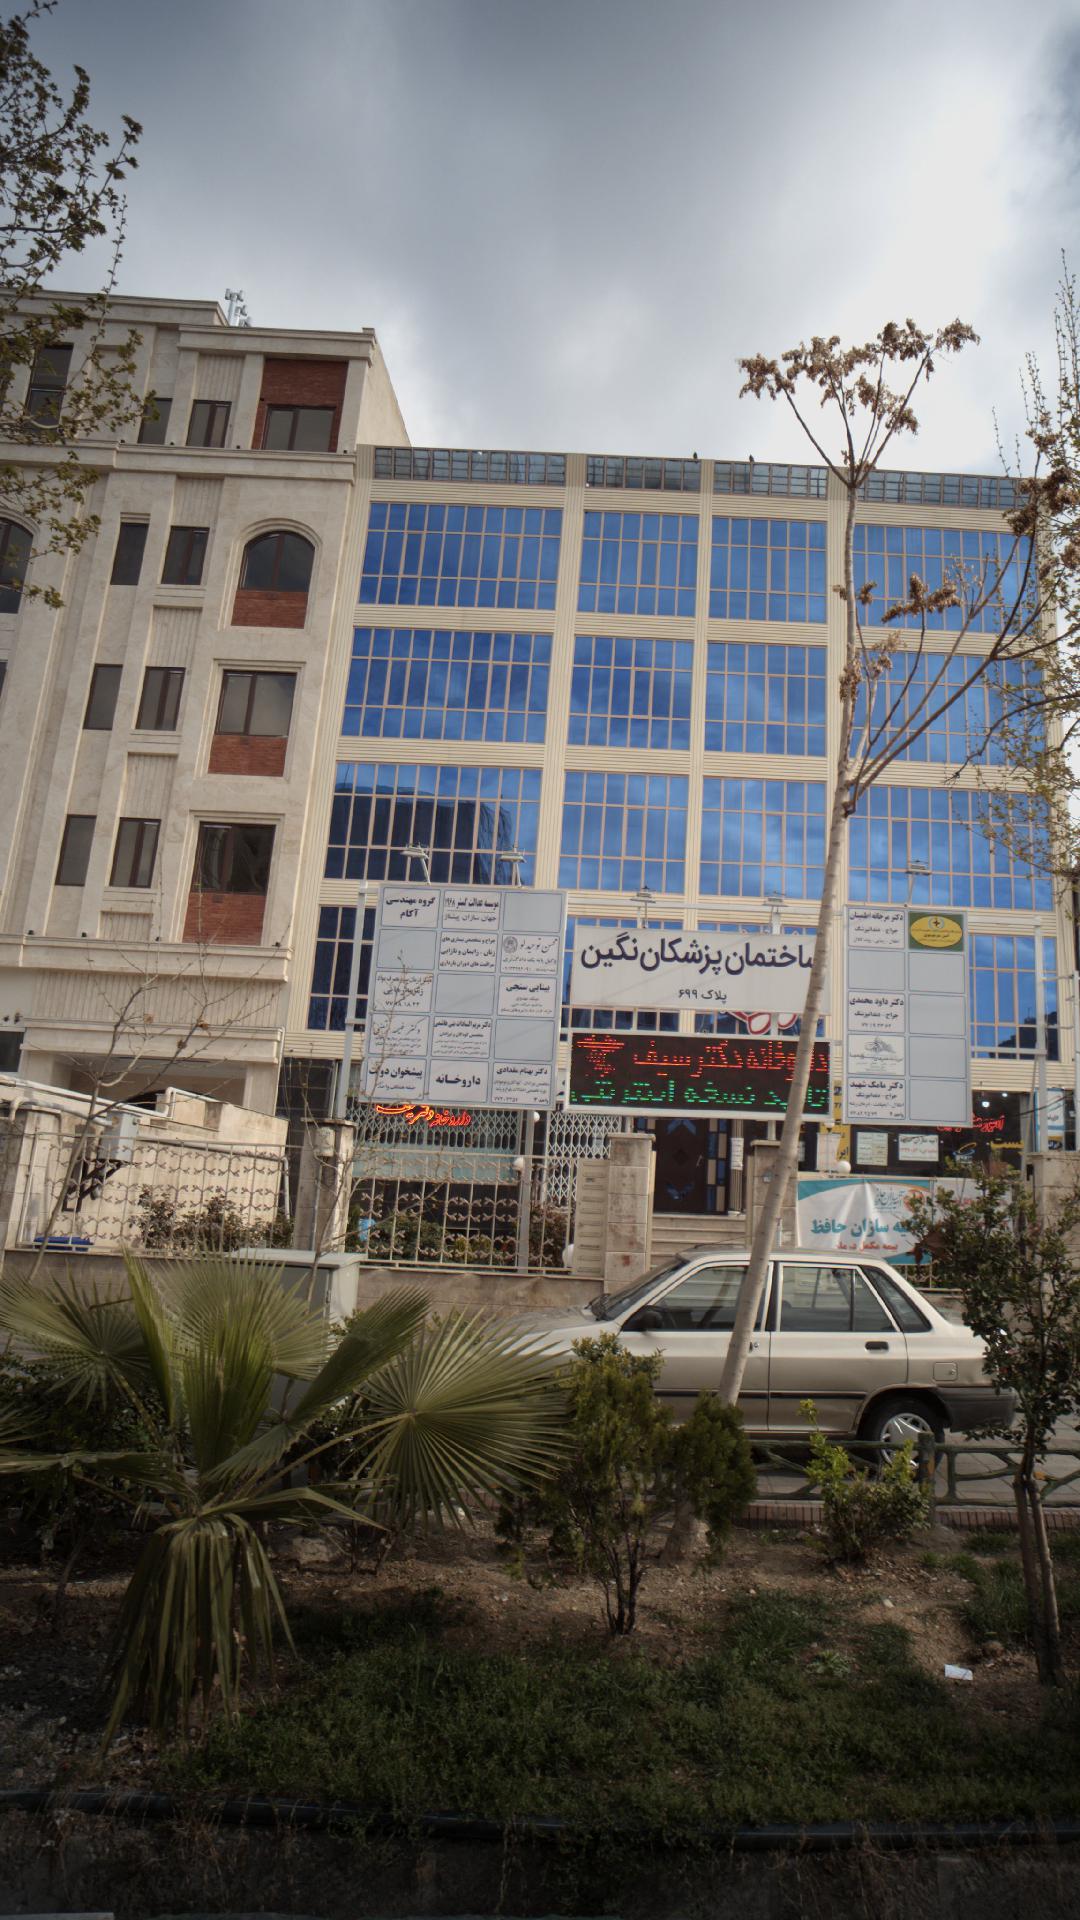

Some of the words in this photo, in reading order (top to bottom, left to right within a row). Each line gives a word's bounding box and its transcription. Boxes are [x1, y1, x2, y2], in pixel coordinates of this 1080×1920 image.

[386, 897, 417, 905] مهندسی
[418, 897, 436, 907] گروه
[400, 908, 420, 920] آکام
[891, 914, 904, 922] دکتر
[581, 931, 639, 969] نگین
[640, 937, 723, 974] پزشکان
[678, 989, 699, 1000] ۶۹۹
[700, 988, 728, 1003] پلاک
[890, 998, 904, 1007] دکتر
[391, 1066, 423, 1079] پیشخوان
[534, 1068, 548, 1076] دکتر
[436, 1074, 481, 1088] داروخانه
[888, 1081, 904, 1091] دکتر
[811, 1218, 848, 1234] حافظ
[851, 1217, 888, 1237] سازان
